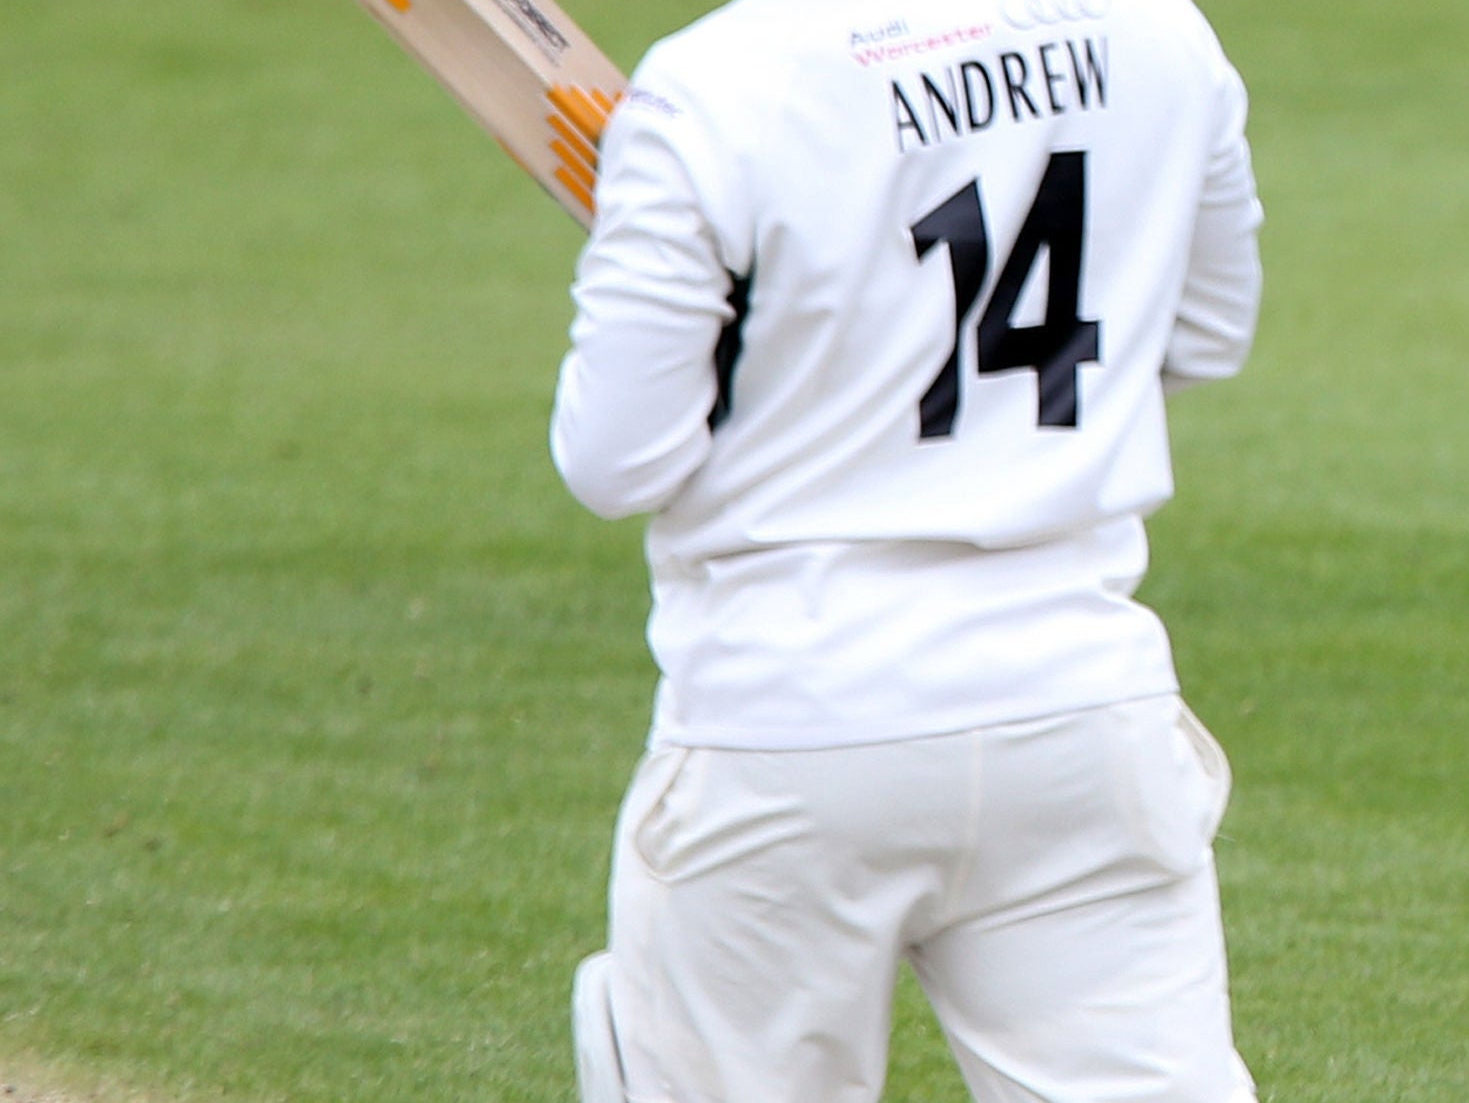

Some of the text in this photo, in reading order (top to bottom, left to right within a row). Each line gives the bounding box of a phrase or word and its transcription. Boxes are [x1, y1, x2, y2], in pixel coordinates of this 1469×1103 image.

[850, 18, 909, 46] Audi
[891, 36, 1108, 153] ANDREW
[910, 150, 1100, 439] 14
